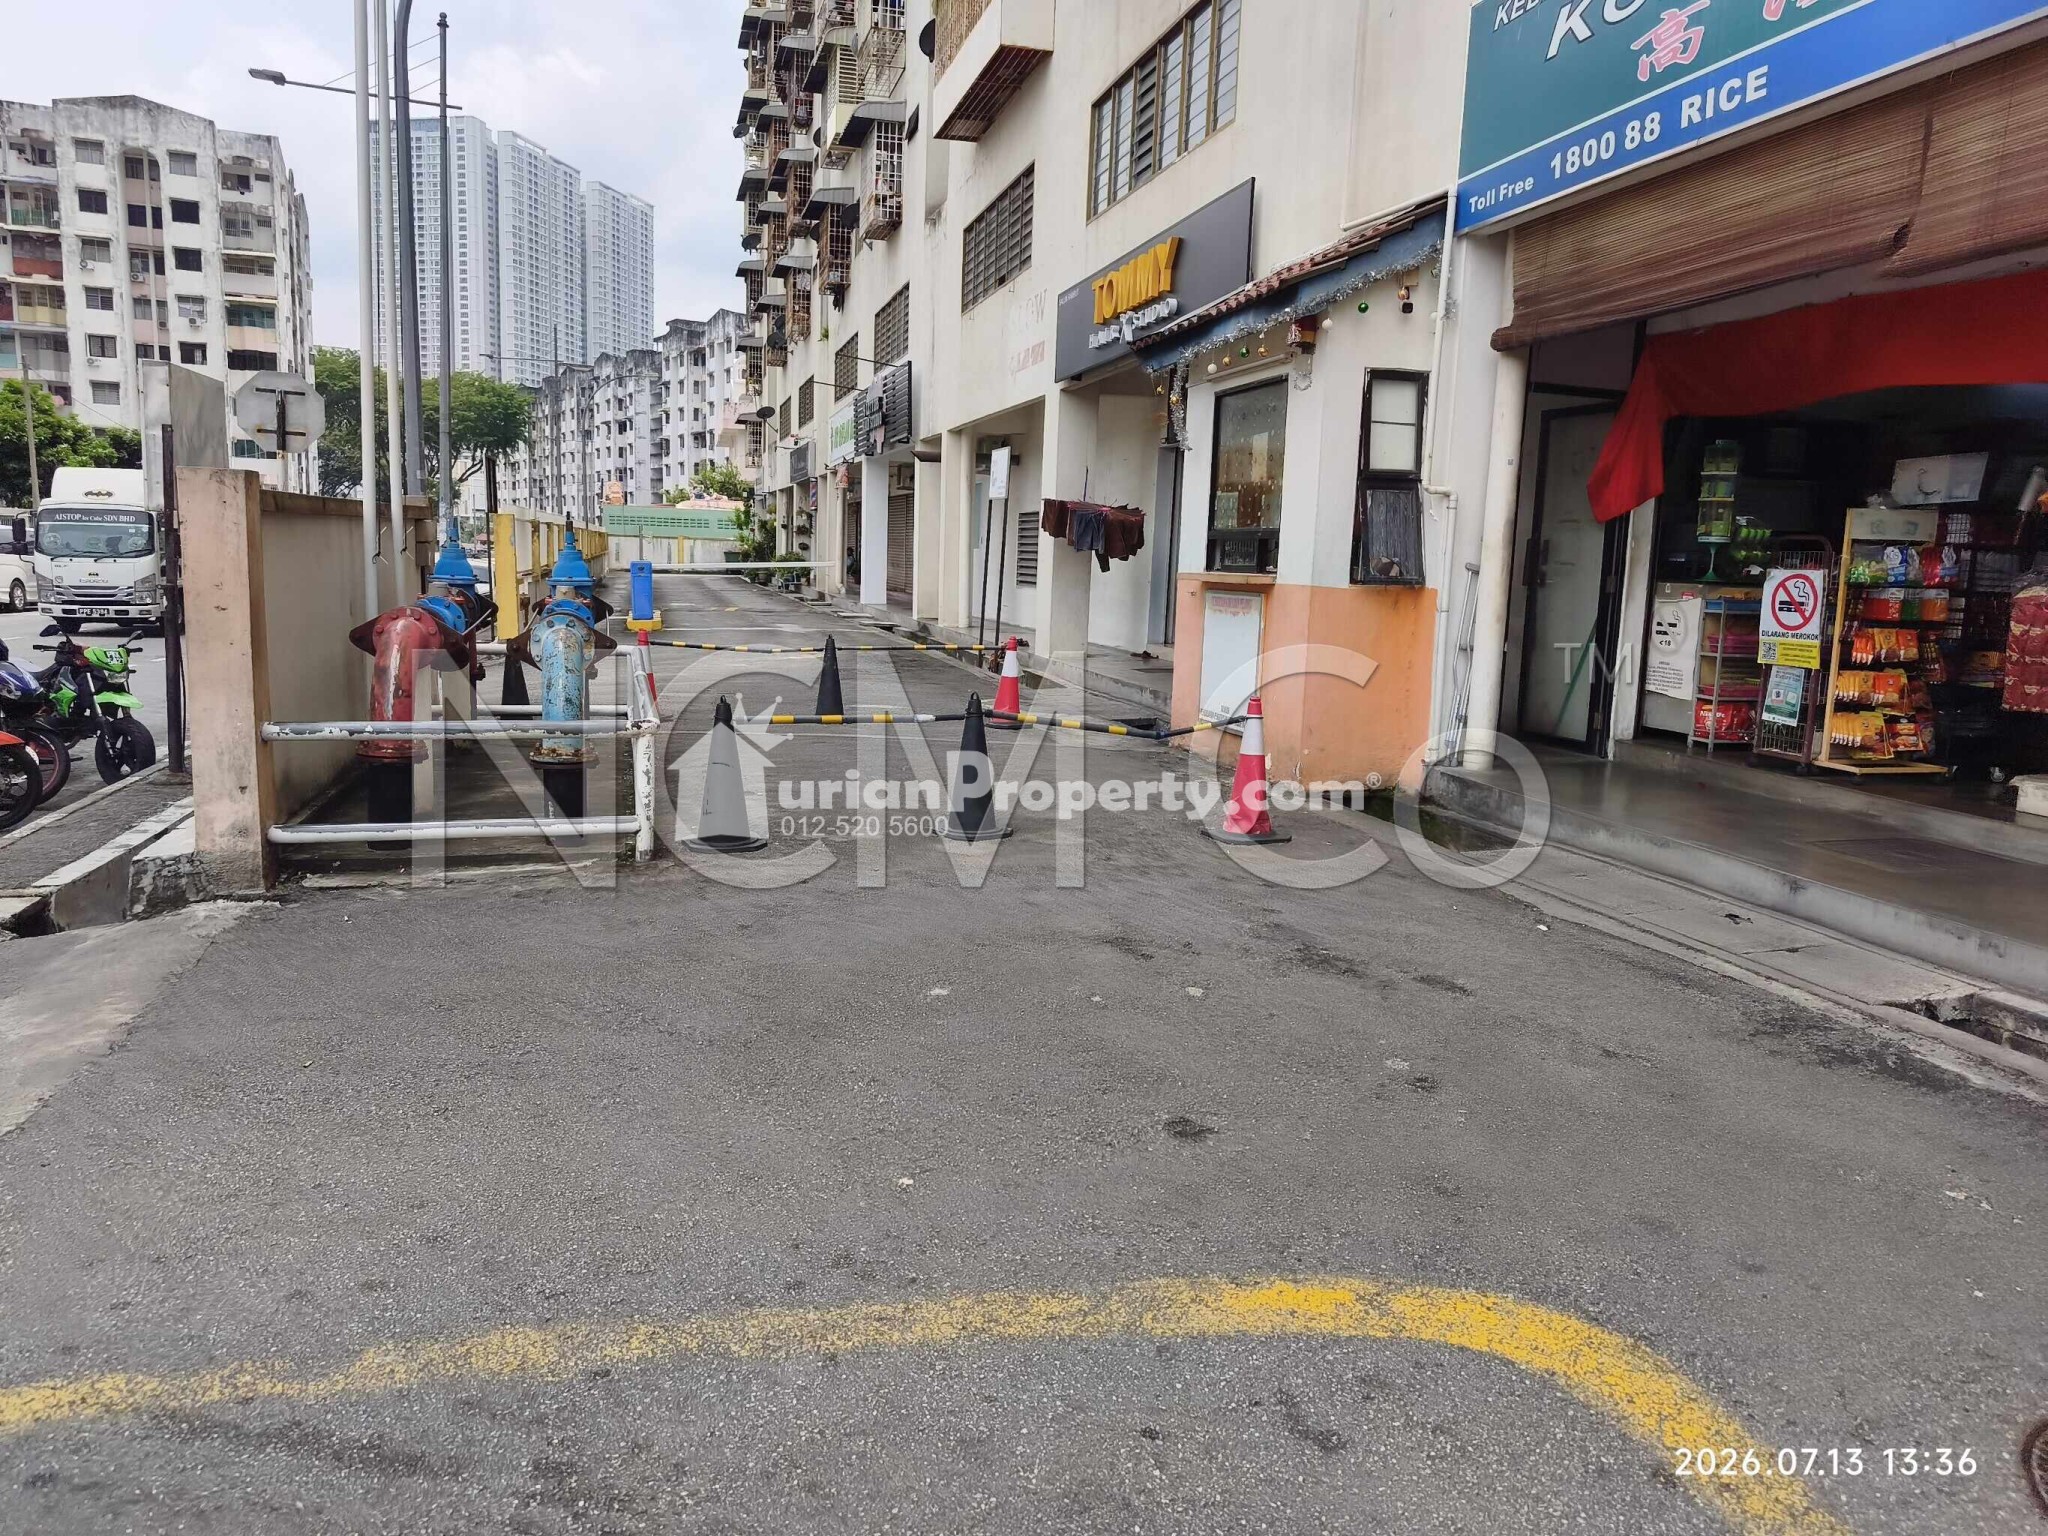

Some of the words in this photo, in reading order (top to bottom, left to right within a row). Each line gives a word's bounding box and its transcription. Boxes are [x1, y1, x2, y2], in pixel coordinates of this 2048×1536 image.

[1469, 190, 1496, 213] Toll
[1499, 176, 1534, 202] Free
[1550, 131, 1616, 179] 1800
[1624, 112, 1661, 150] 88
[1680, 65, 1769, 129] RICE
[1091, 236, 1184, 324] TOMMY
[103, 514, 118, 522] SDN
[119, 515, 136, 523] BHD
[1761, 629, 1790, 639] DILARANG
[1790, 632, 1819, 641] MEROKOK
